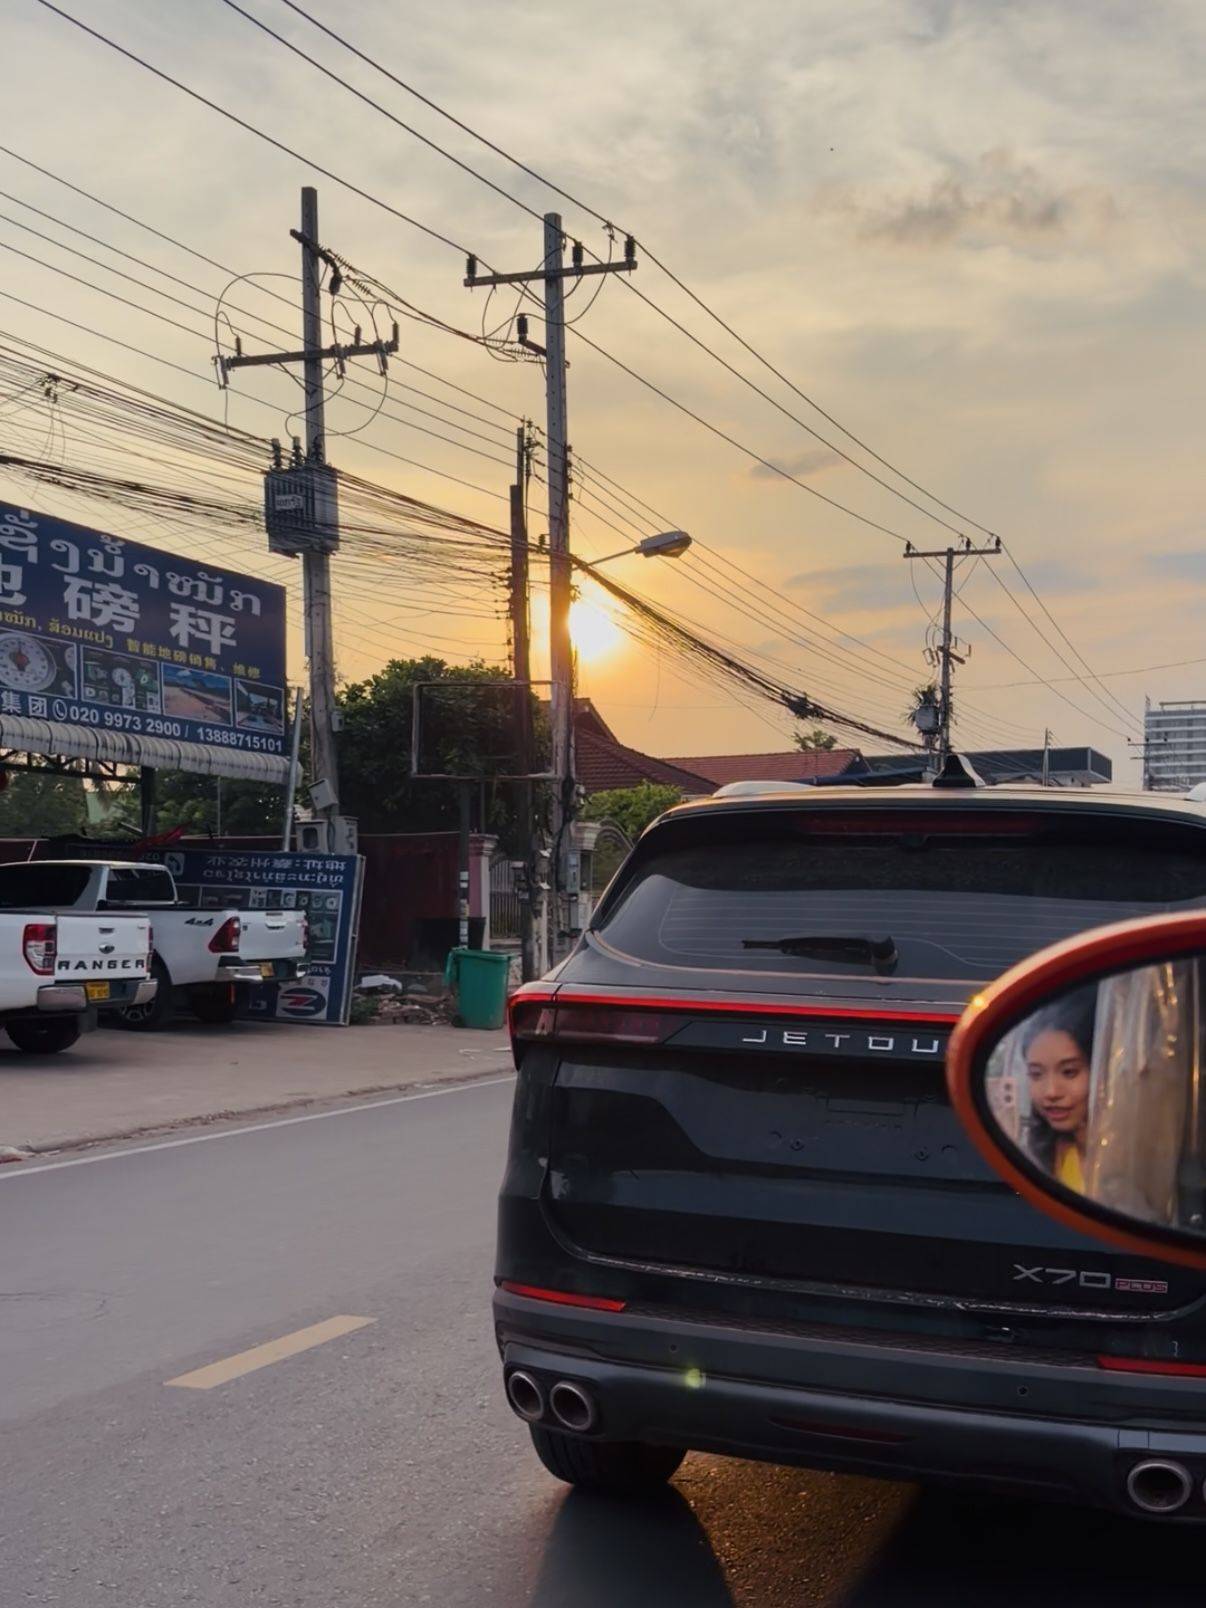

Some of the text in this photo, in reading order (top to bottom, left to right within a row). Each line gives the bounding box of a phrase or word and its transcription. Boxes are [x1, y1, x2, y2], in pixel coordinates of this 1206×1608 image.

[1, 690, 48, 718] 集团
[69, 705, 100, 724] 020
[104, 713, 142, 731] 9973
[146, 718, 181, 737] 2900
[196, 727, 283, 752] 13888715101
[57, 958, 145, 971] RANGER
[1012, 1264, 1111, 1288] X70
